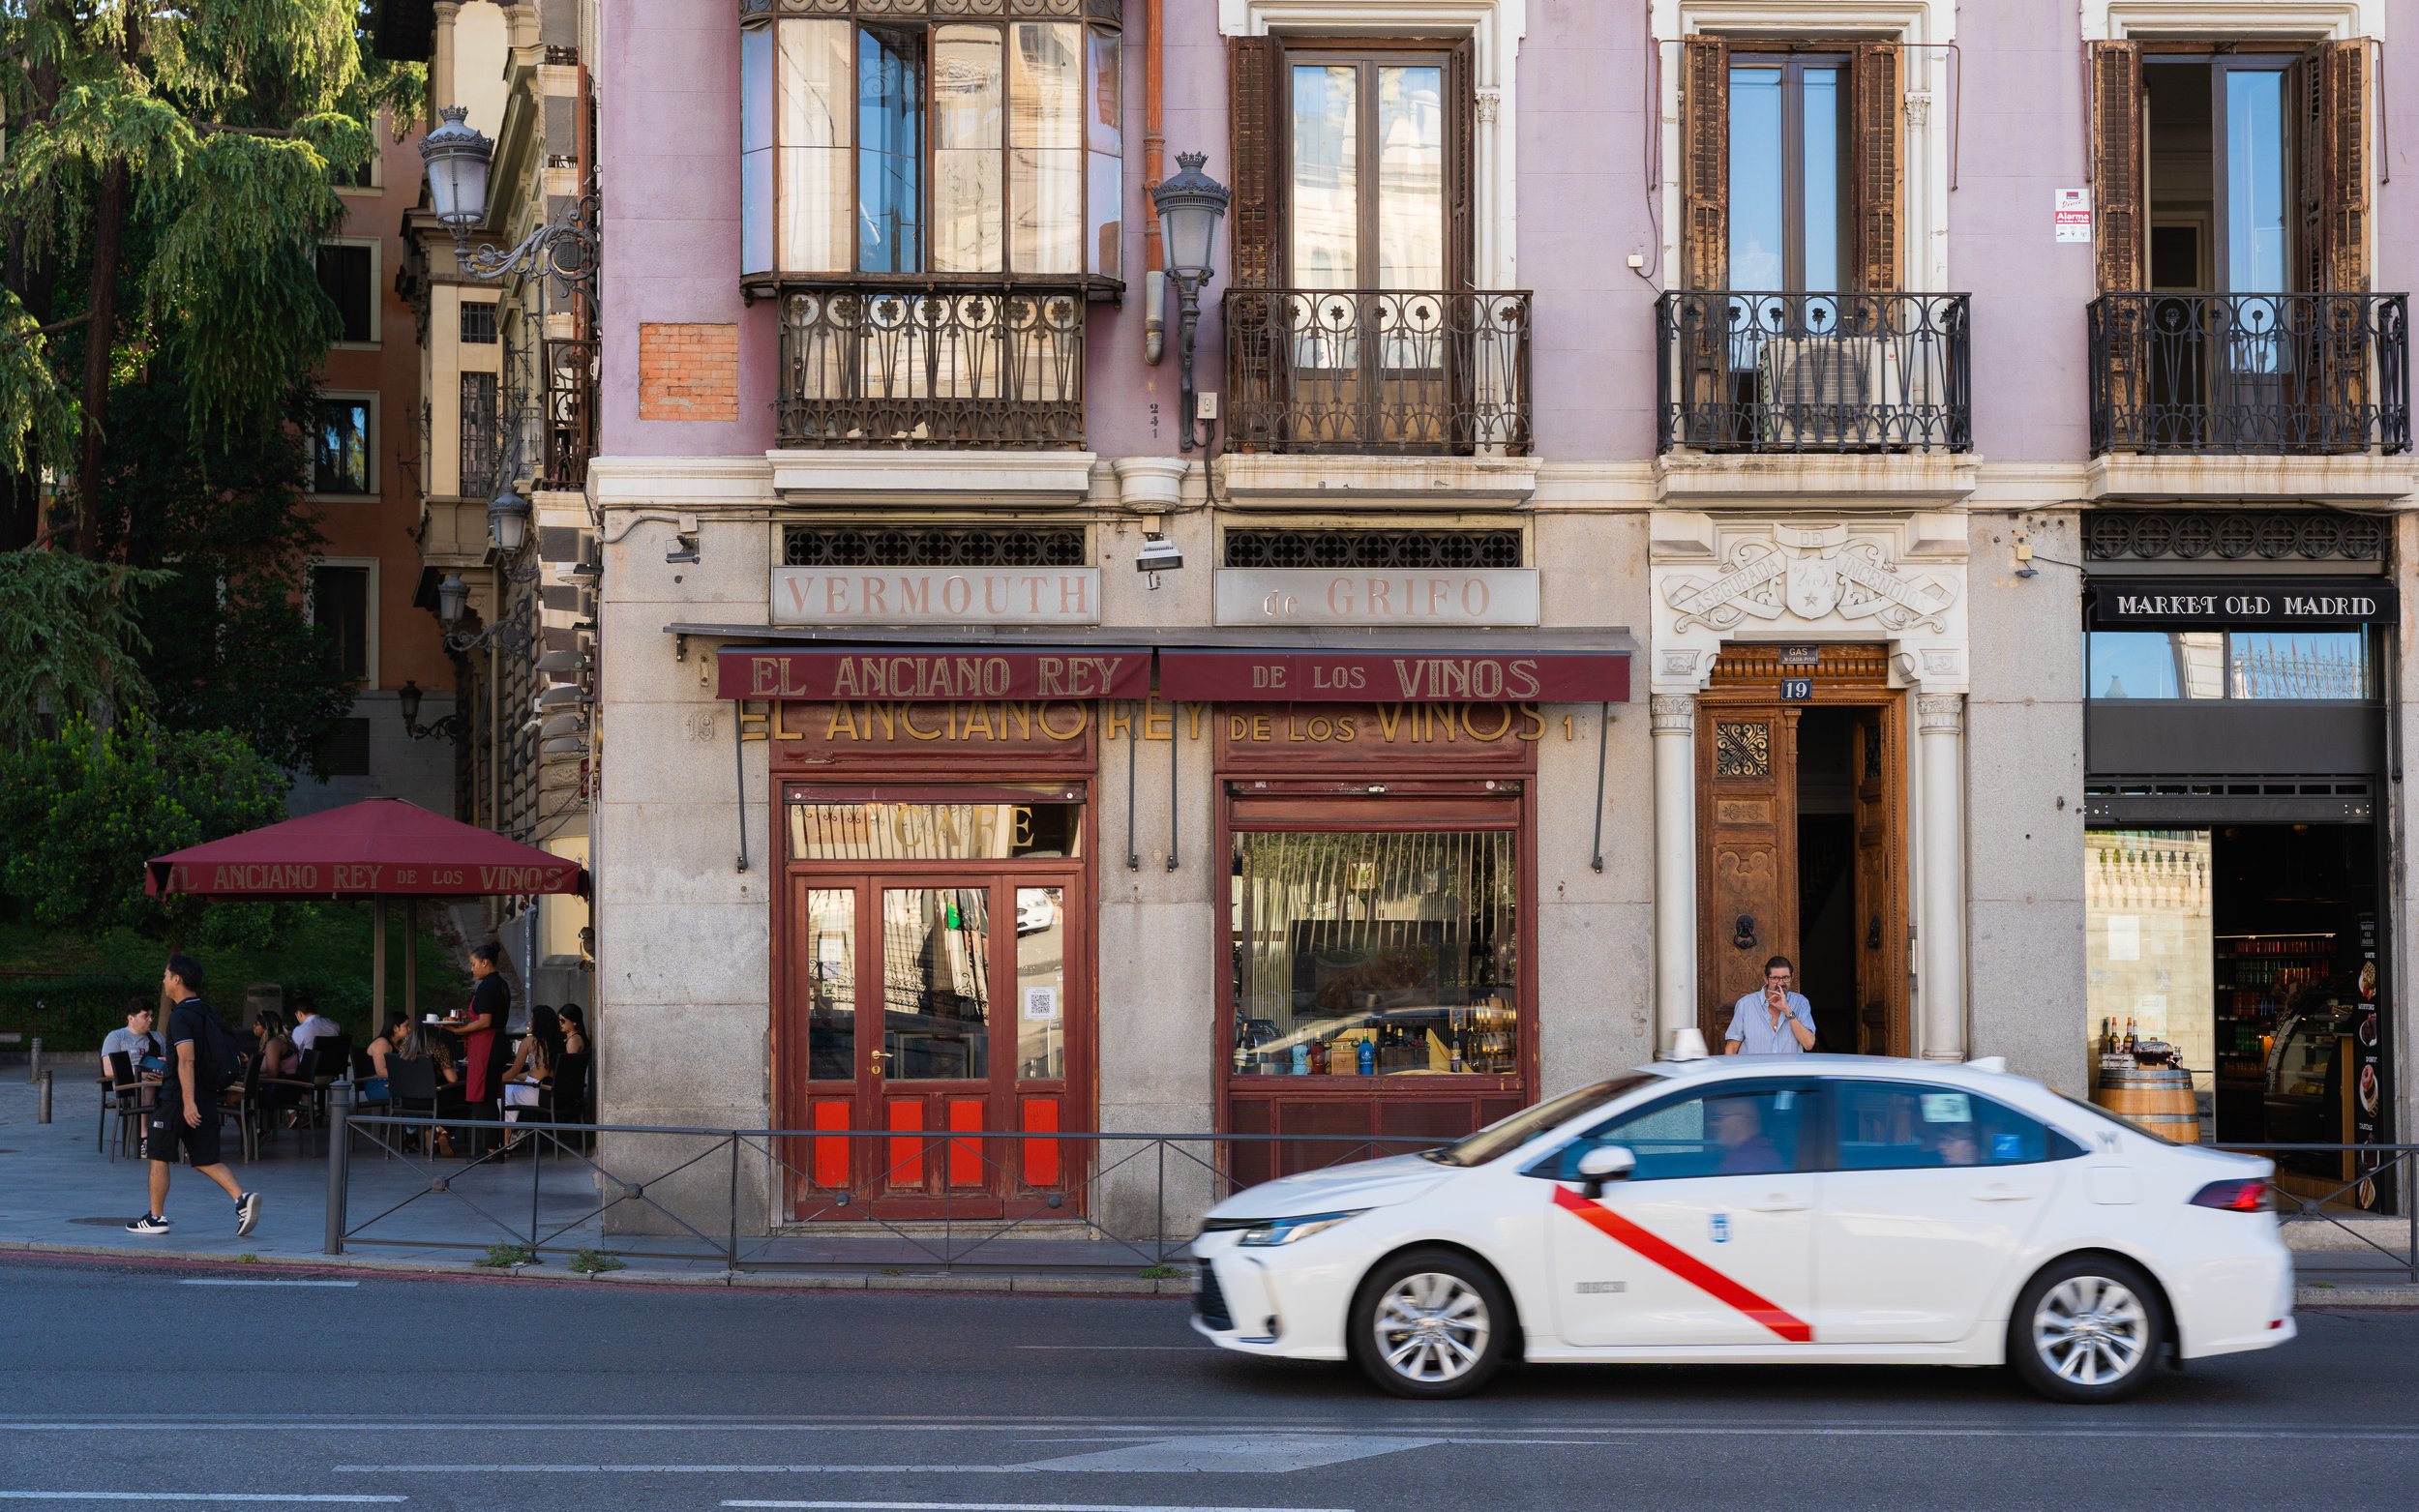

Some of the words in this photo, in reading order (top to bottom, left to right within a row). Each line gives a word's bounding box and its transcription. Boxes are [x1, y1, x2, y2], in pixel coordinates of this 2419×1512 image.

[2056, 212, 2089, 221] Alarma
[1800, 532, 1824, 547] DE
[785, 576, 1088, 614] VERMOUTH
[1264, 589, 1299, 616] de
[1328, 578, 1490, 616] GRIFO
[1694, 557, 1783, 614] ASEGURADA
[1842, 555, 1929, 612] INCENDIOS
[2117, 596, 2218, 614] MARKET
[2225, 596, 2271, 614] OLD
[2283, 596, 2376, 615] MADRID
[1789, 647, 1808, 656] GAS
[751, 657, 807, 696] EL
[832, 656, 1010, 697] ANCIANO
[1037, 657, 1122, 696] REY
[1252, 666, 1287, 689] DE
[1313, 666, 1366, 689] LOS
[1393, 659, 1540, 698] VINOS
[1785, 682, 1808, 698] 19
[739, 699, 804, 740] EL
[825, 699, 1088, 741] ANCIANO
[1108, 691, 1206, 740] REY
[1230, 714, 1271, 741] DE
[1288, 714, 1355, 742] LOS
[1376, 701, 1547, 742] VINOS
[894, 806, 1035, 847] CAFE
[167, 866, 198, 891] EL
[213, 864, 317, 890] ANCIANO
[333, 865, 384, 889] REY
[397, 870, 417, 884] DE
[432, 870, 463, 885] LOS
[479, 866, 563, 891] VINOS
